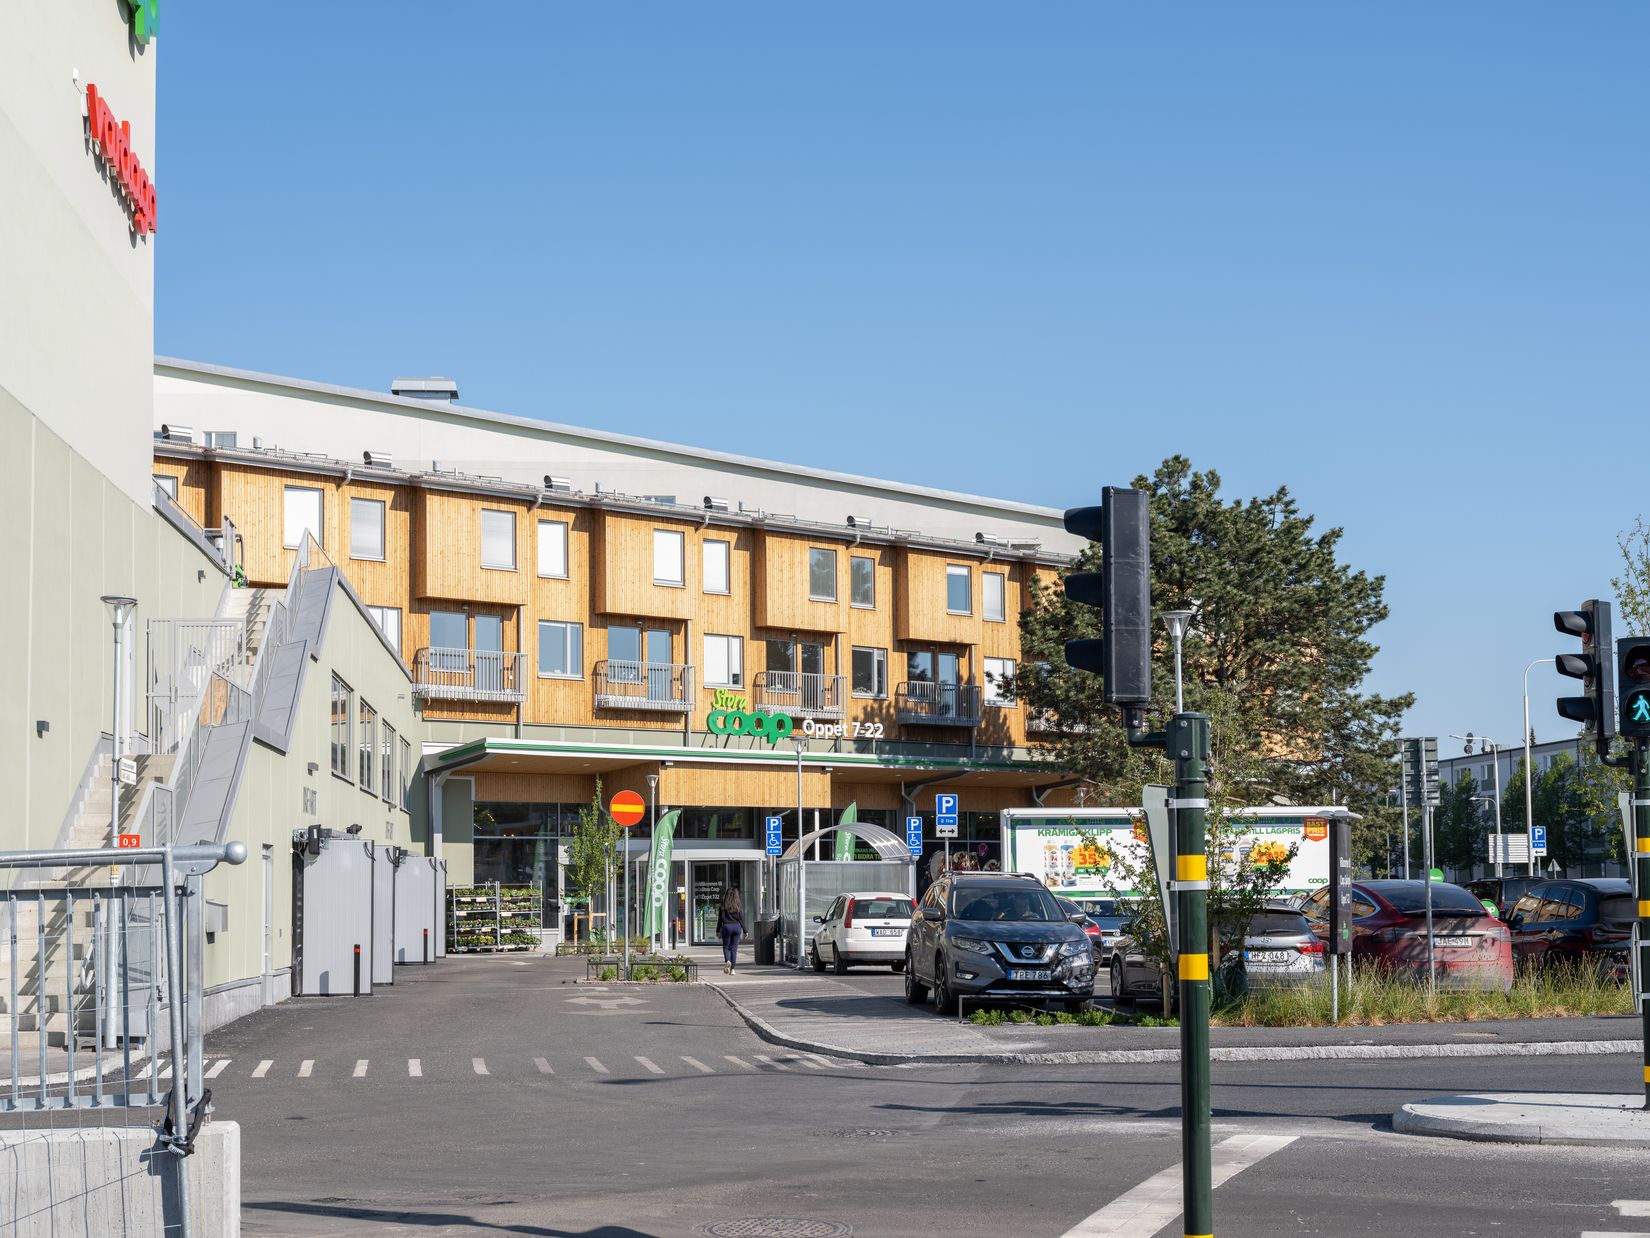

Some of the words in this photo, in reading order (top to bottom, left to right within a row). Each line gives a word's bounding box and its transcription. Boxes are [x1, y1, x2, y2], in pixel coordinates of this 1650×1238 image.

[711, 688, 748, 710] Stora
[707, 709, 793, 745] coop
[802, 716, 848, 739] Öppet
[851, 722, 884, 738] 7-22
[942, 796, 954, 814] P
[770, 818, 779, 831] P
[910, 818, 919, 831] P
[1534, 828, 1544, 840] P
[122, 838, 137, 848] 0,9
[1014, 970, 1031, 979] TPE
[1032, 970, 1049, 979] 786
